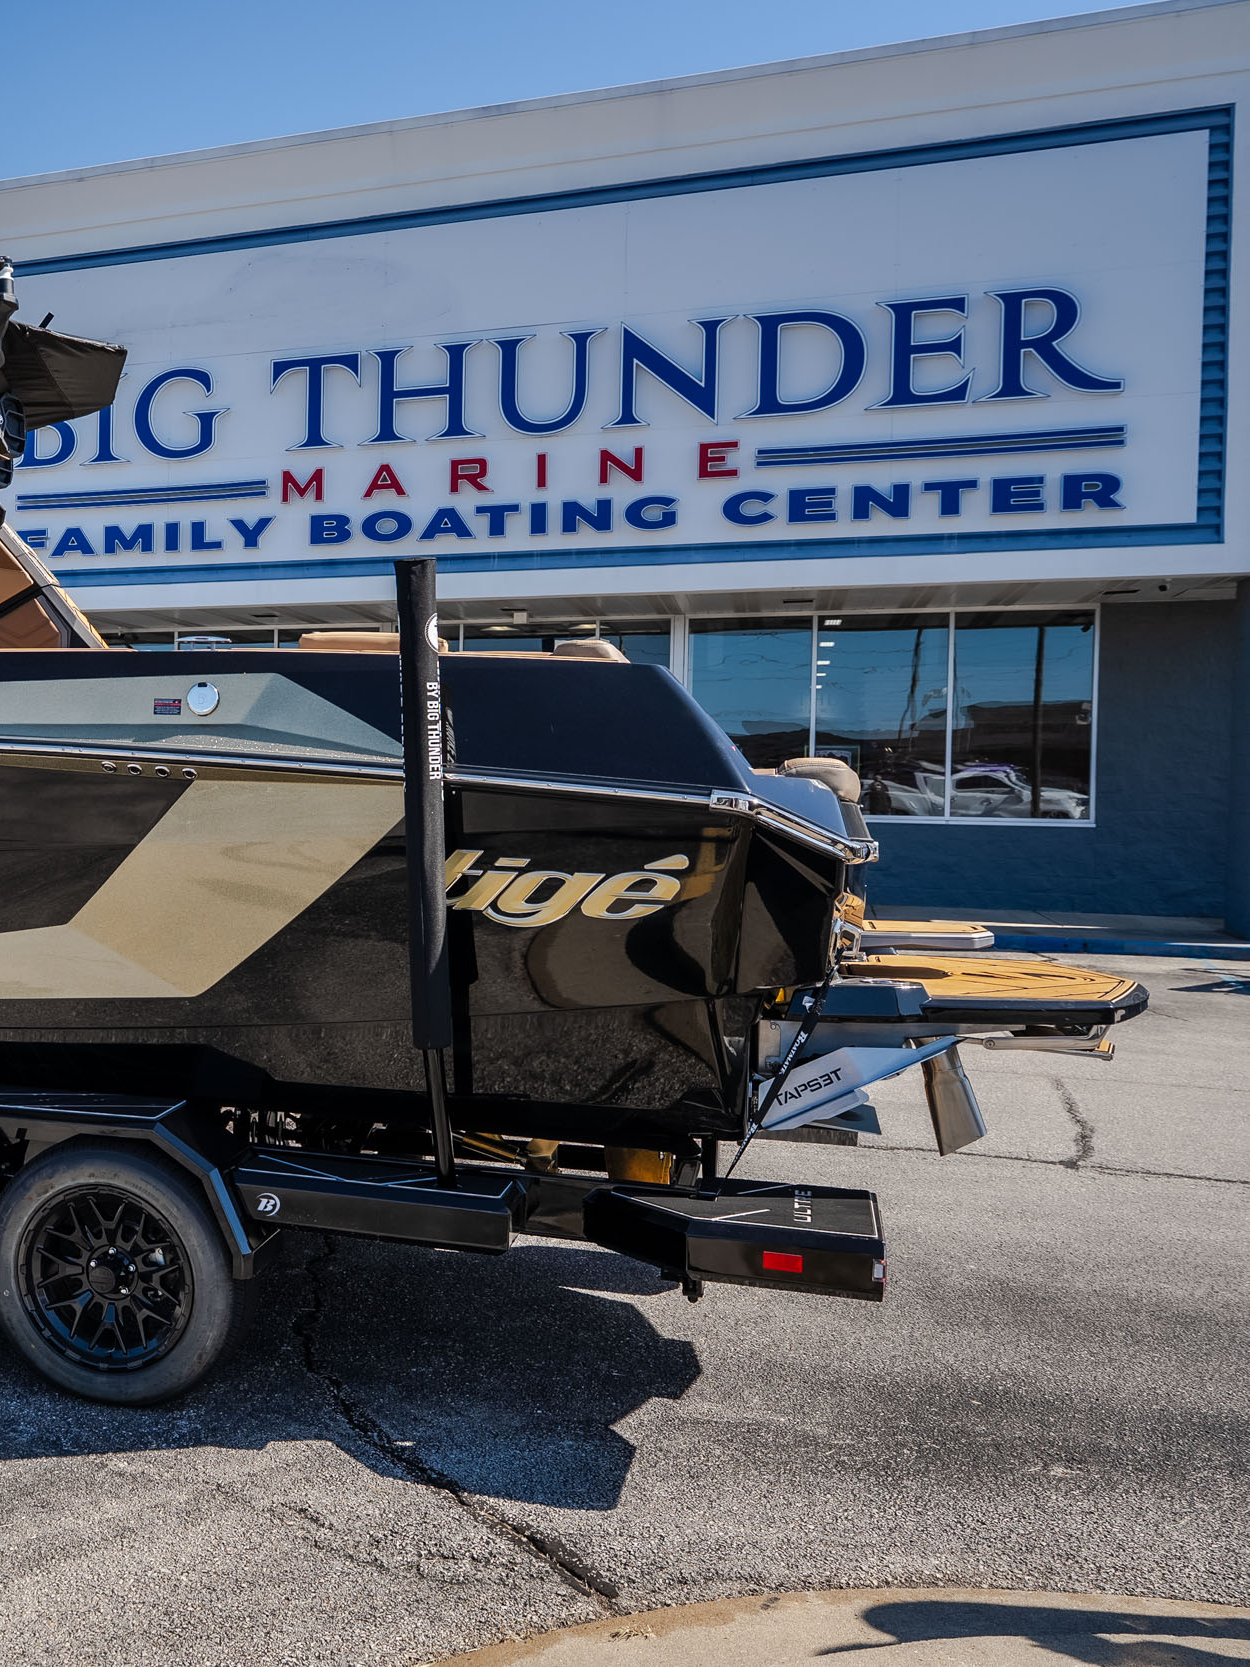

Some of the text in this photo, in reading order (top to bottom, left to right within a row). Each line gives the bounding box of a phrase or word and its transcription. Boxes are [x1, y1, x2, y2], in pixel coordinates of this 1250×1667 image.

[270, 287, 1124, 451] THUNDER
[281, 439, 740, 503] MARINE
[16, 472, 1126, 558] FAMILY BOATING CENTER
[426, 681, 442, 780] BY BIG THUNDER
[445, 849, 689, 927] tigé
